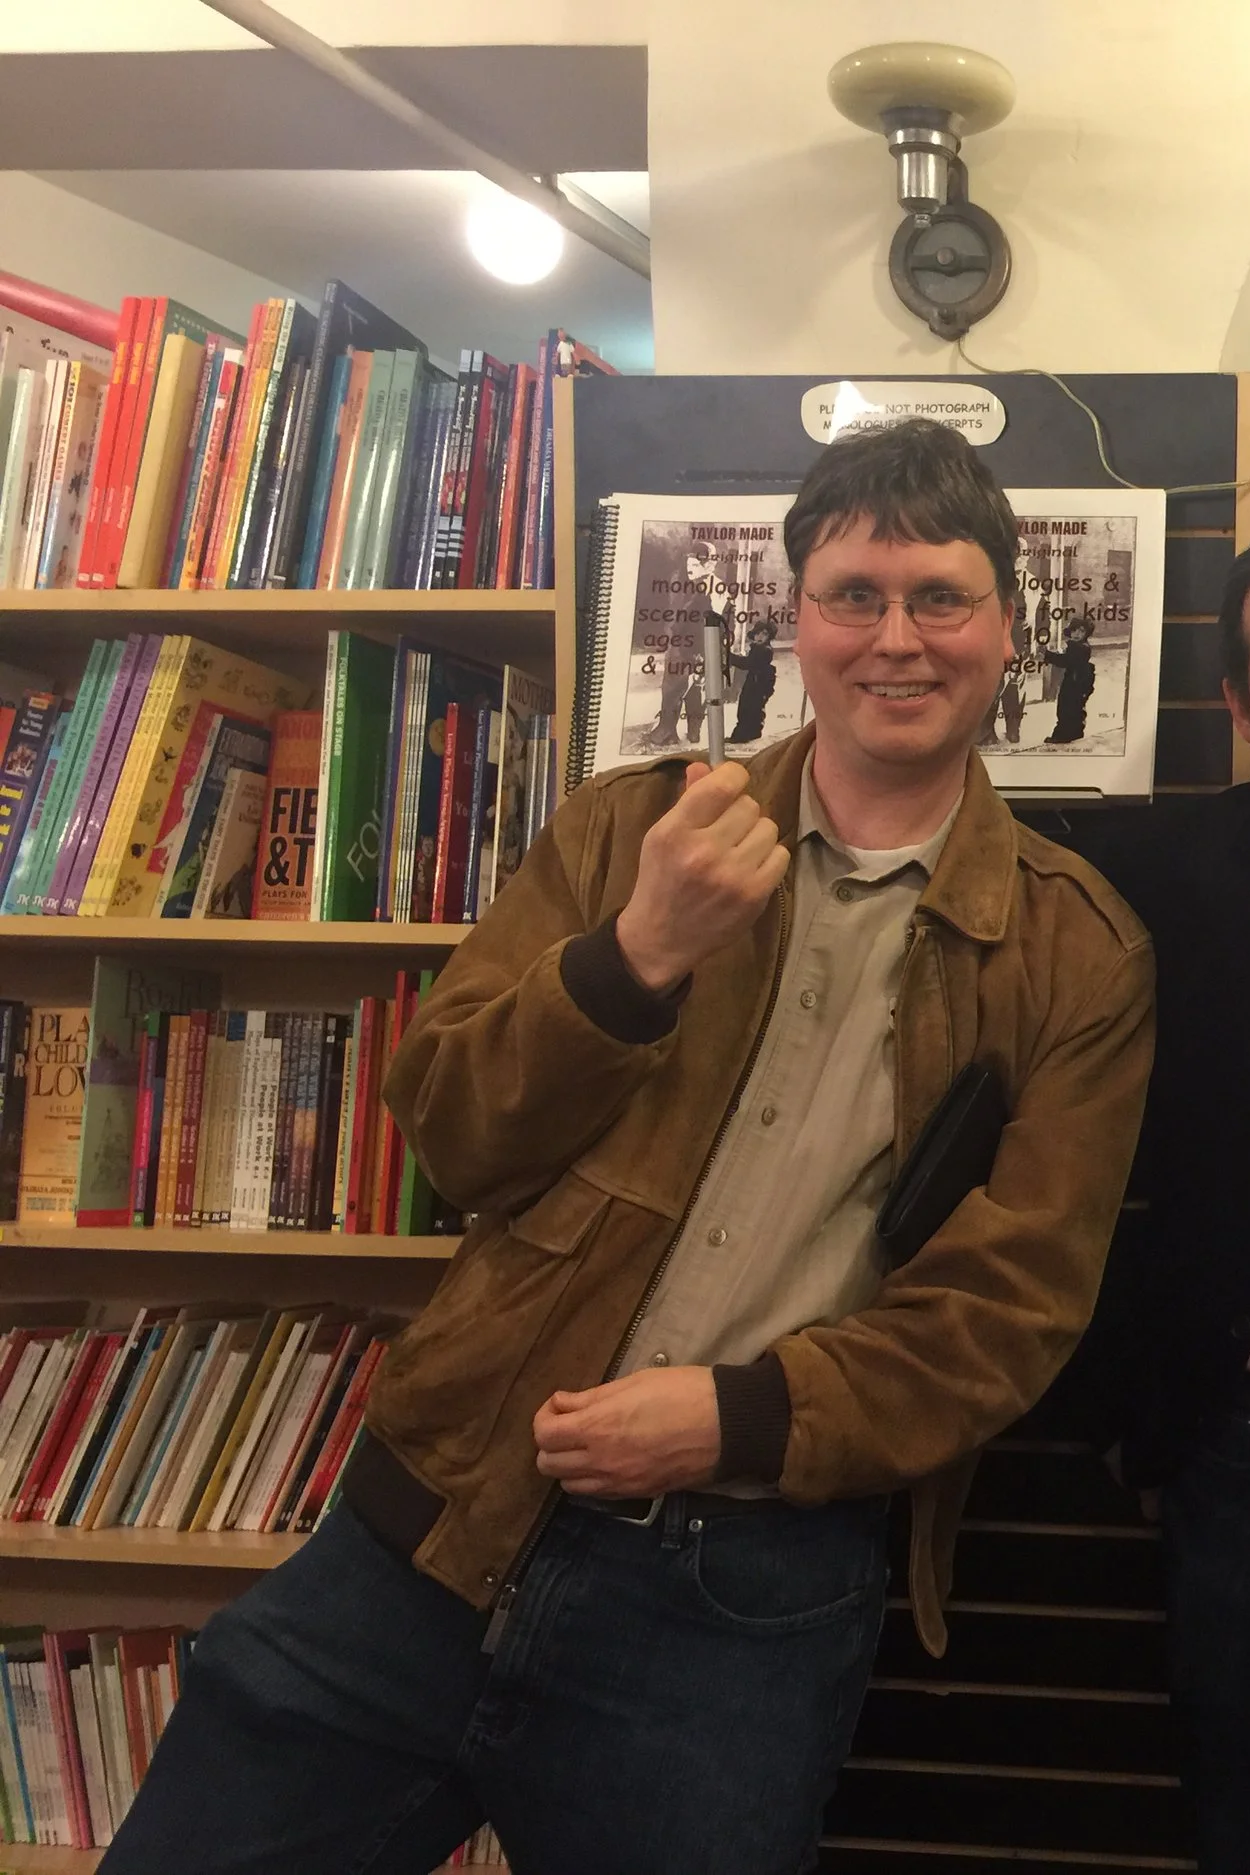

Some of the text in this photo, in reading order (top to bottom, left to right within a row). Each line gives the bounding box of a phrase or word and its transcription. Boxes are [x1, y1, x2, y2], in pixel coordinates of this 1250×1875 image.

[886, 402, 990, 415] NOT PHOTOGRAPH
[691, 527, 774, 541] TAYLOR MADE
[1051, 522, 1087, 535] MADE
[652, 576, 777, 597] monologues
[1104, 573, 1119, 592] &
[1039, 602, 1129, 621] for kids
[644, 634, 694, 652] ages
[641, 656, 656, 676] &
[334, 656, 346, 756] FOLKTALES ON STAGE
[264, 837, 289, 886] &
[262, 890, 307, 898] PLAYS FOR
[257, 1084, 267, 1120] People
[267, 1084, 277, 1120] People
[256, 1122, 264, 1134] at
[267, 1122, 274, 1134] at
[255, 1136, 264, 1162] Work
[265, 1136, 274, 1163] Work
